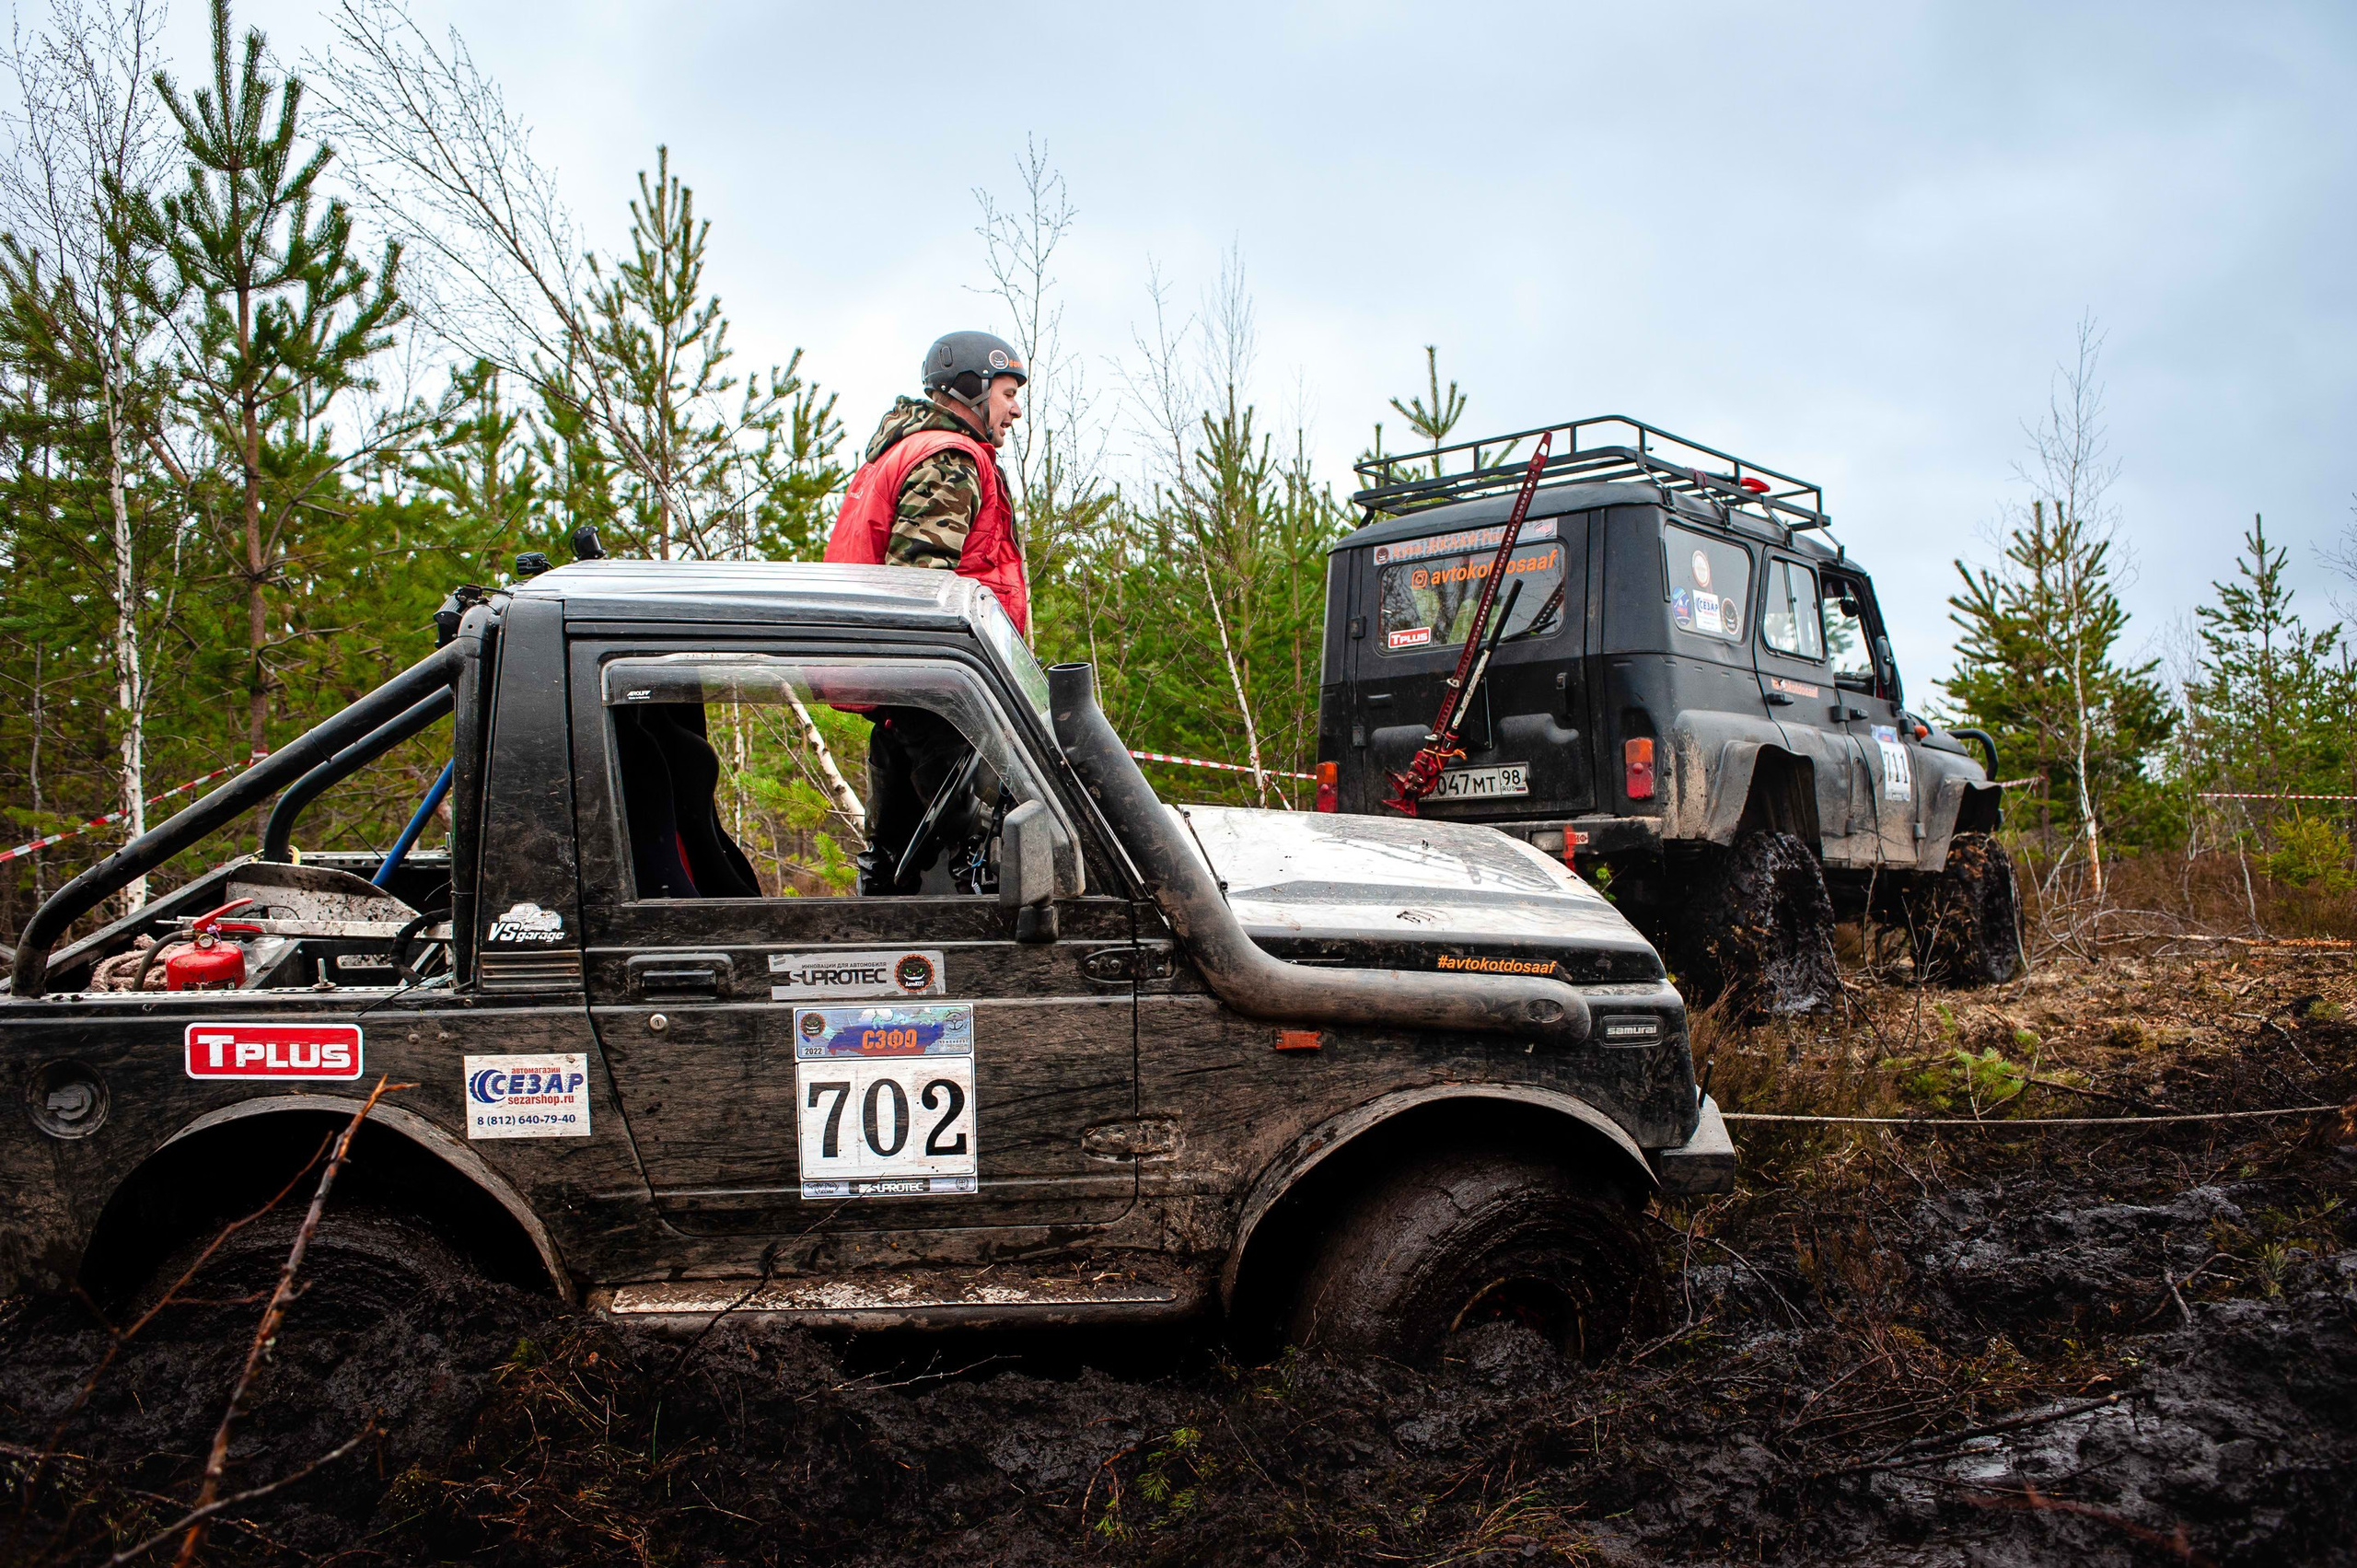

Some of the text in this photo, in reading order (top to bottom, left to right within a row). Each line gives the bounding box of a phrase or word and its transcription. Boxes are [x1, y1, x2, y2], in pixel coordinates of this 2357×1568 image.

[1391, 633, 1428, 645] TPLUS
[1883, 750, 1909, 784] 711
[1502, 770, 1521, 785] 98
[1437, 955, 1558, 974] #avtokotdosaaf
[789, 969, 887, 986] SUPROTEC
[1607, 1026, 1657, 1035] samurai
[862, 1028, 918, 1050] СЗФО
[197, 1035, 352, 1068] TPLUS
[805, 1047, 822, 1055] 2022
[490, 1073, 584, 1095] СЕЗАР
[508, 1094, 575, 1106] sezarshop.ru
[477, 1114, 576, 1126] 8 (812) 640-79-40
[807, 1078, 967, 1158] 702
[870, 1182, 923, 1192] SUPROTEC
